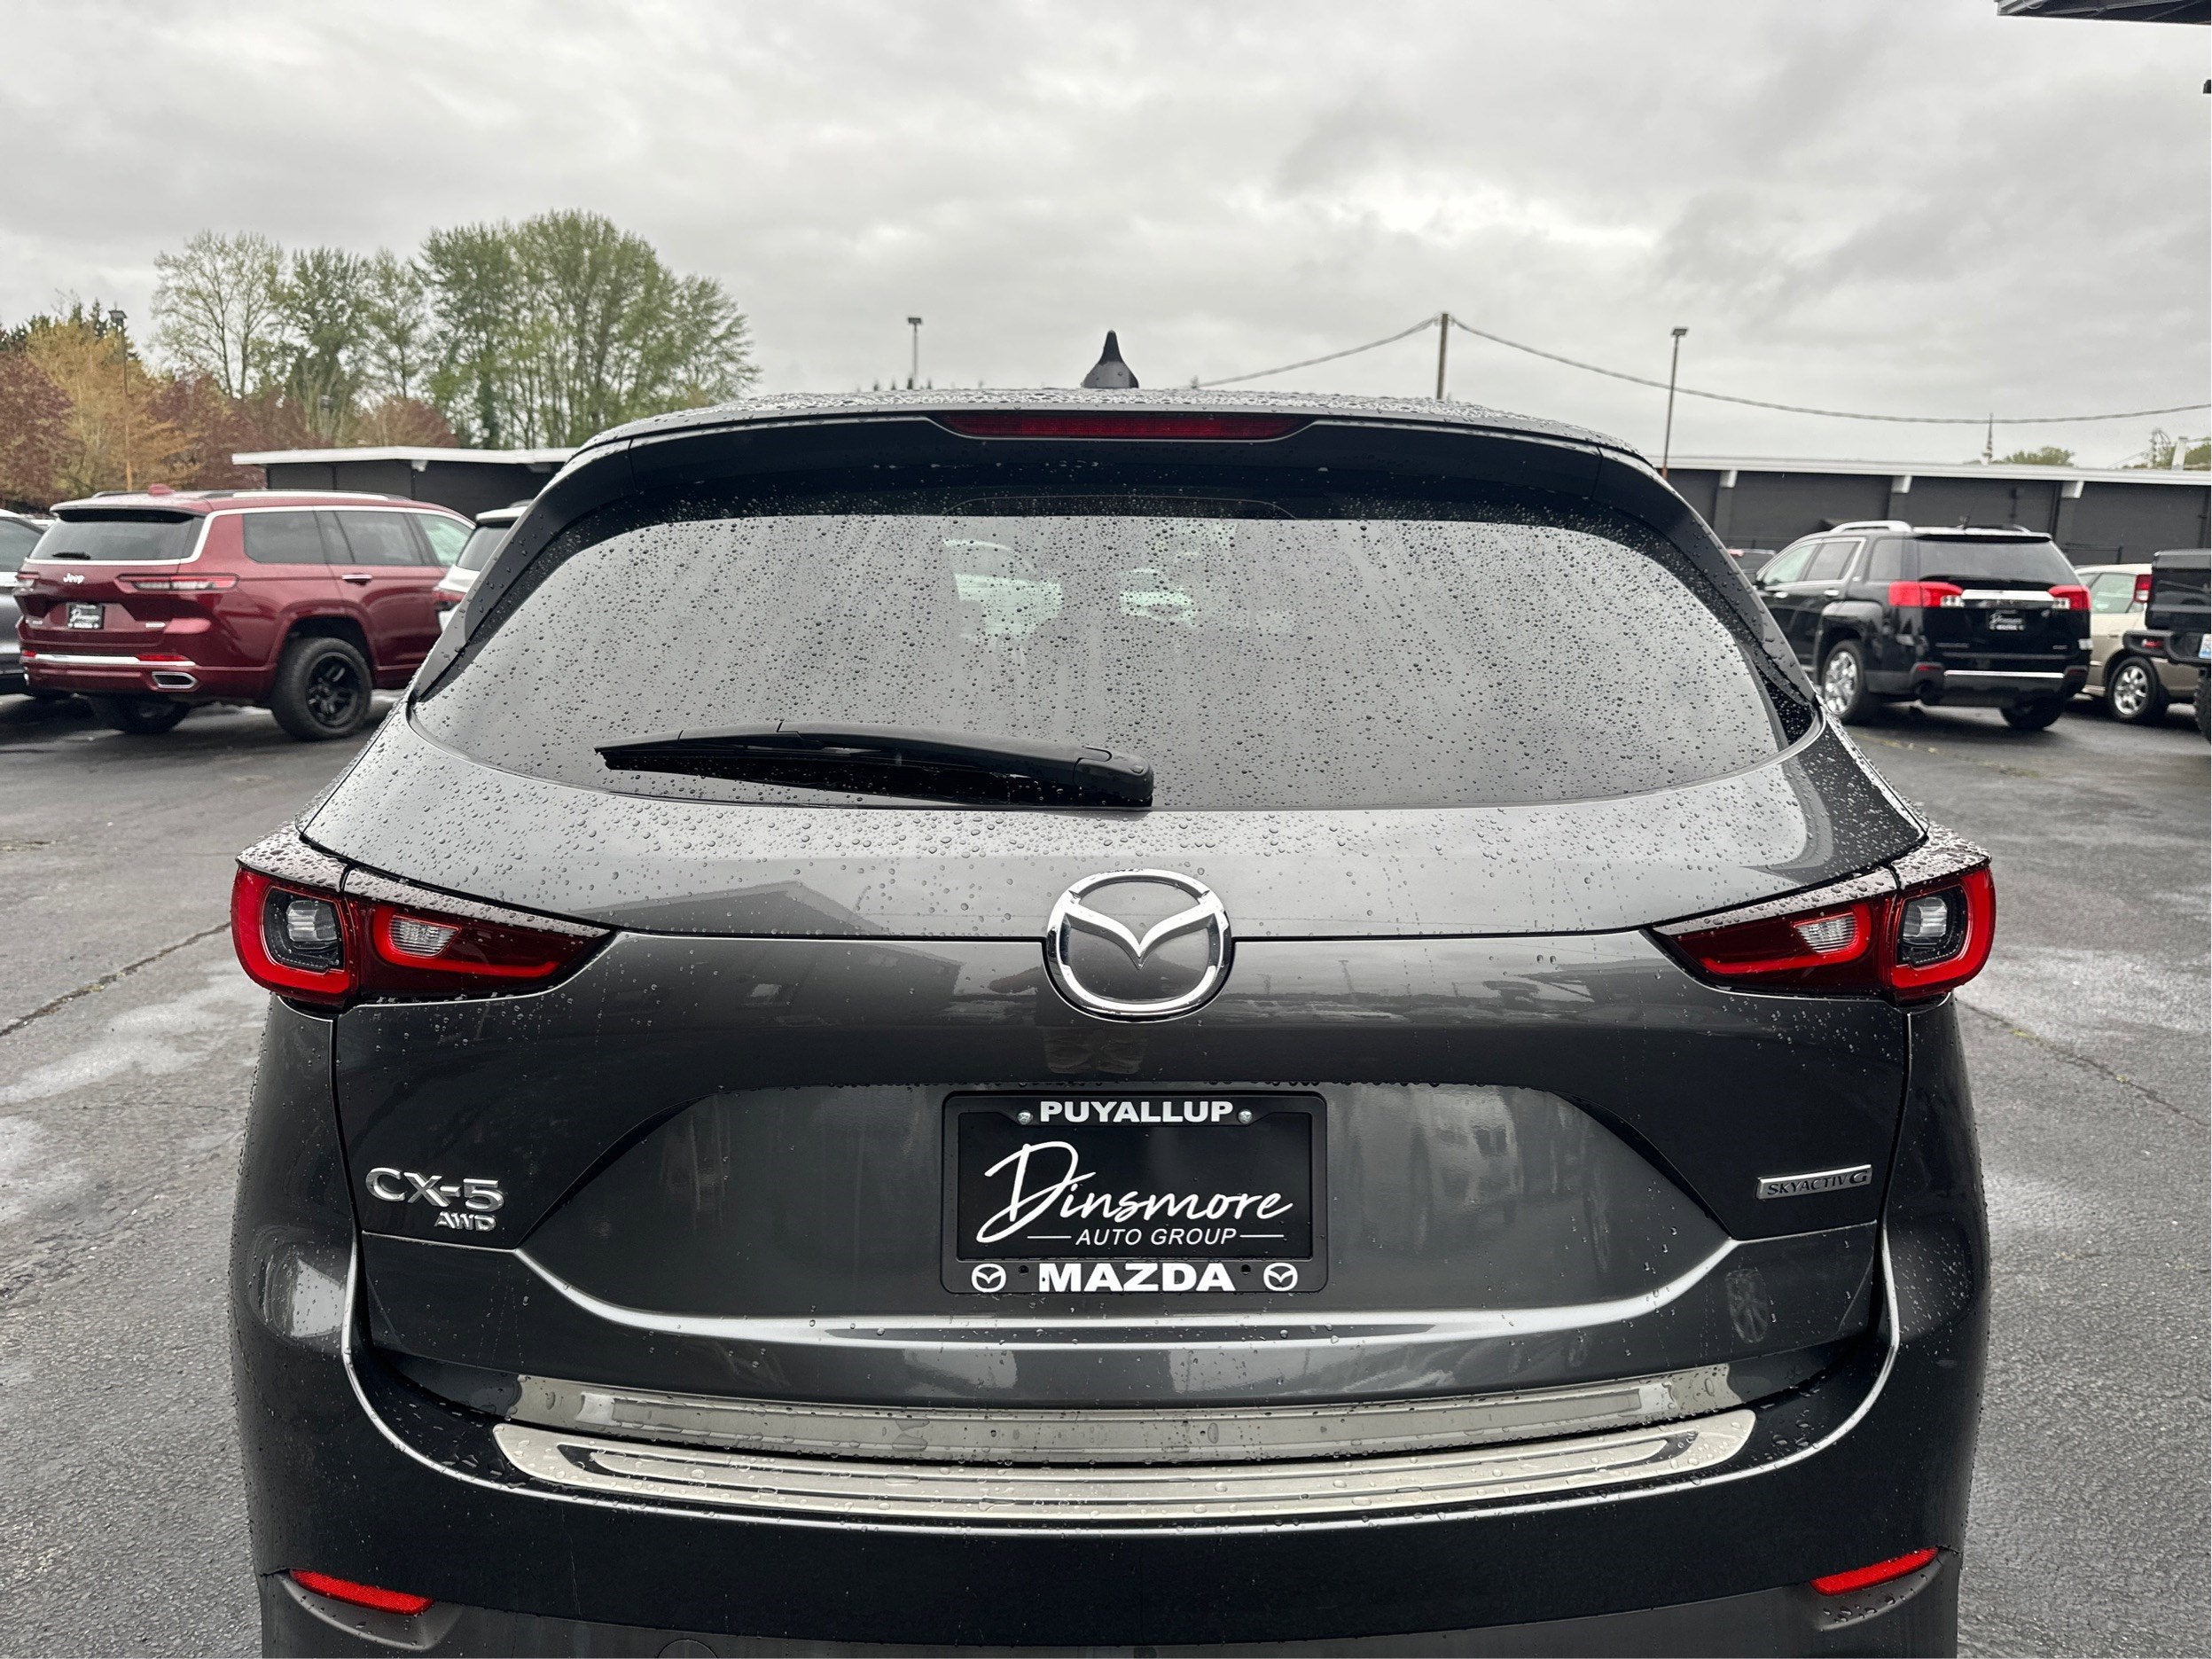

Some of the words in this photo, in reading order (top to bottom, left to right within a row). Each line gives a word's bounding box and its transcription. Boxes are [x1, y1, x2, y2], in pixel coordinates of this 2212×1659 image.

[63, 573, 85, 584] Jeep
[1040, 1100, 1233, 1123] PUYALLUP
[365, 1167, 505, 1213] CX-5
[975, 1141, 1294, 1243] Dinsmore
[434, 1211, 497, 1232] AWD
[1075, 1228, 1142, 1246] AUTO
[1150, 1227, 1237, 1246] GROUP
[1038, 1263, 1236, 1293] MAZDA
